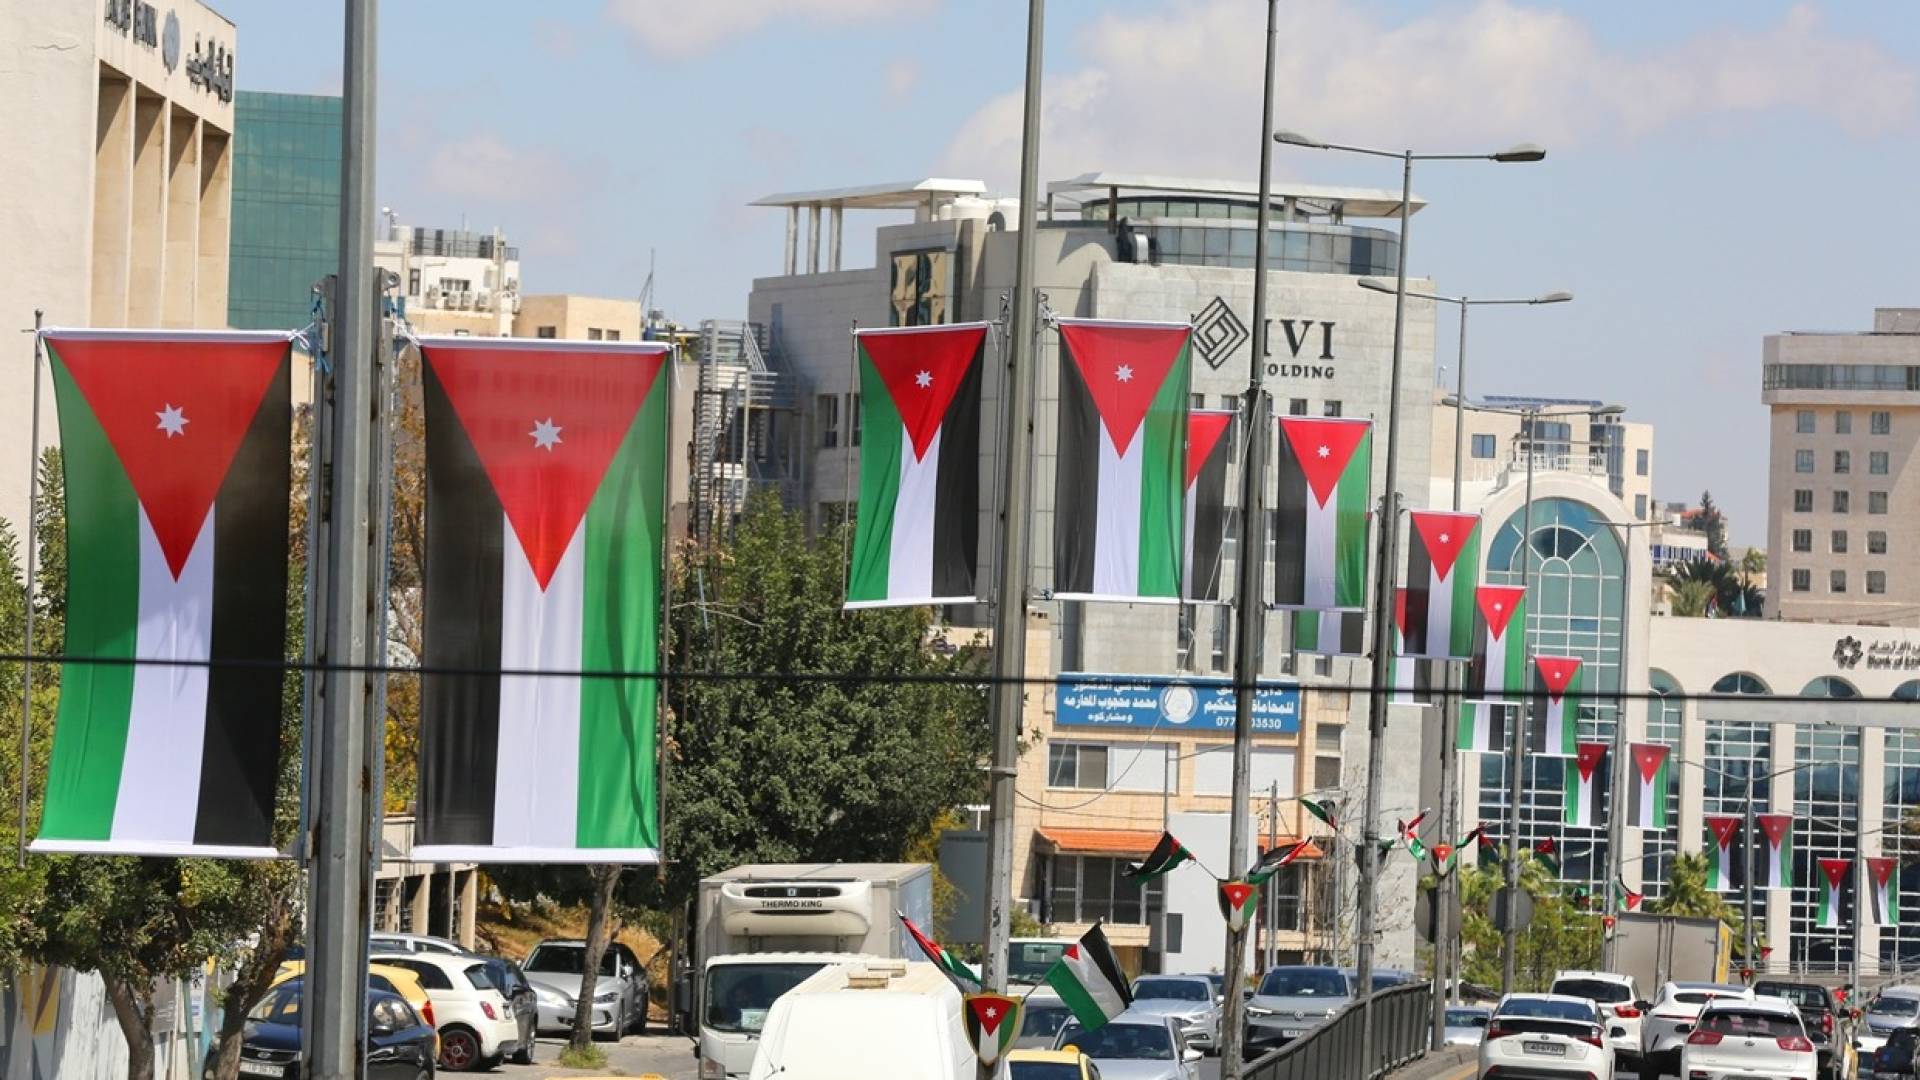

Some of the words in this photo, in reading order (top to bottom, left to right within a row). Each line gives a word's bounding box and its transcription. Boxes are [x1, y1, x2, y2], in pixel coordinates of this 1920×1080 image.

[1263, 363, 1335, 379] OLDING
[761, 900, 799, 909] THERMO
[801, 900, 823, 908] KING
